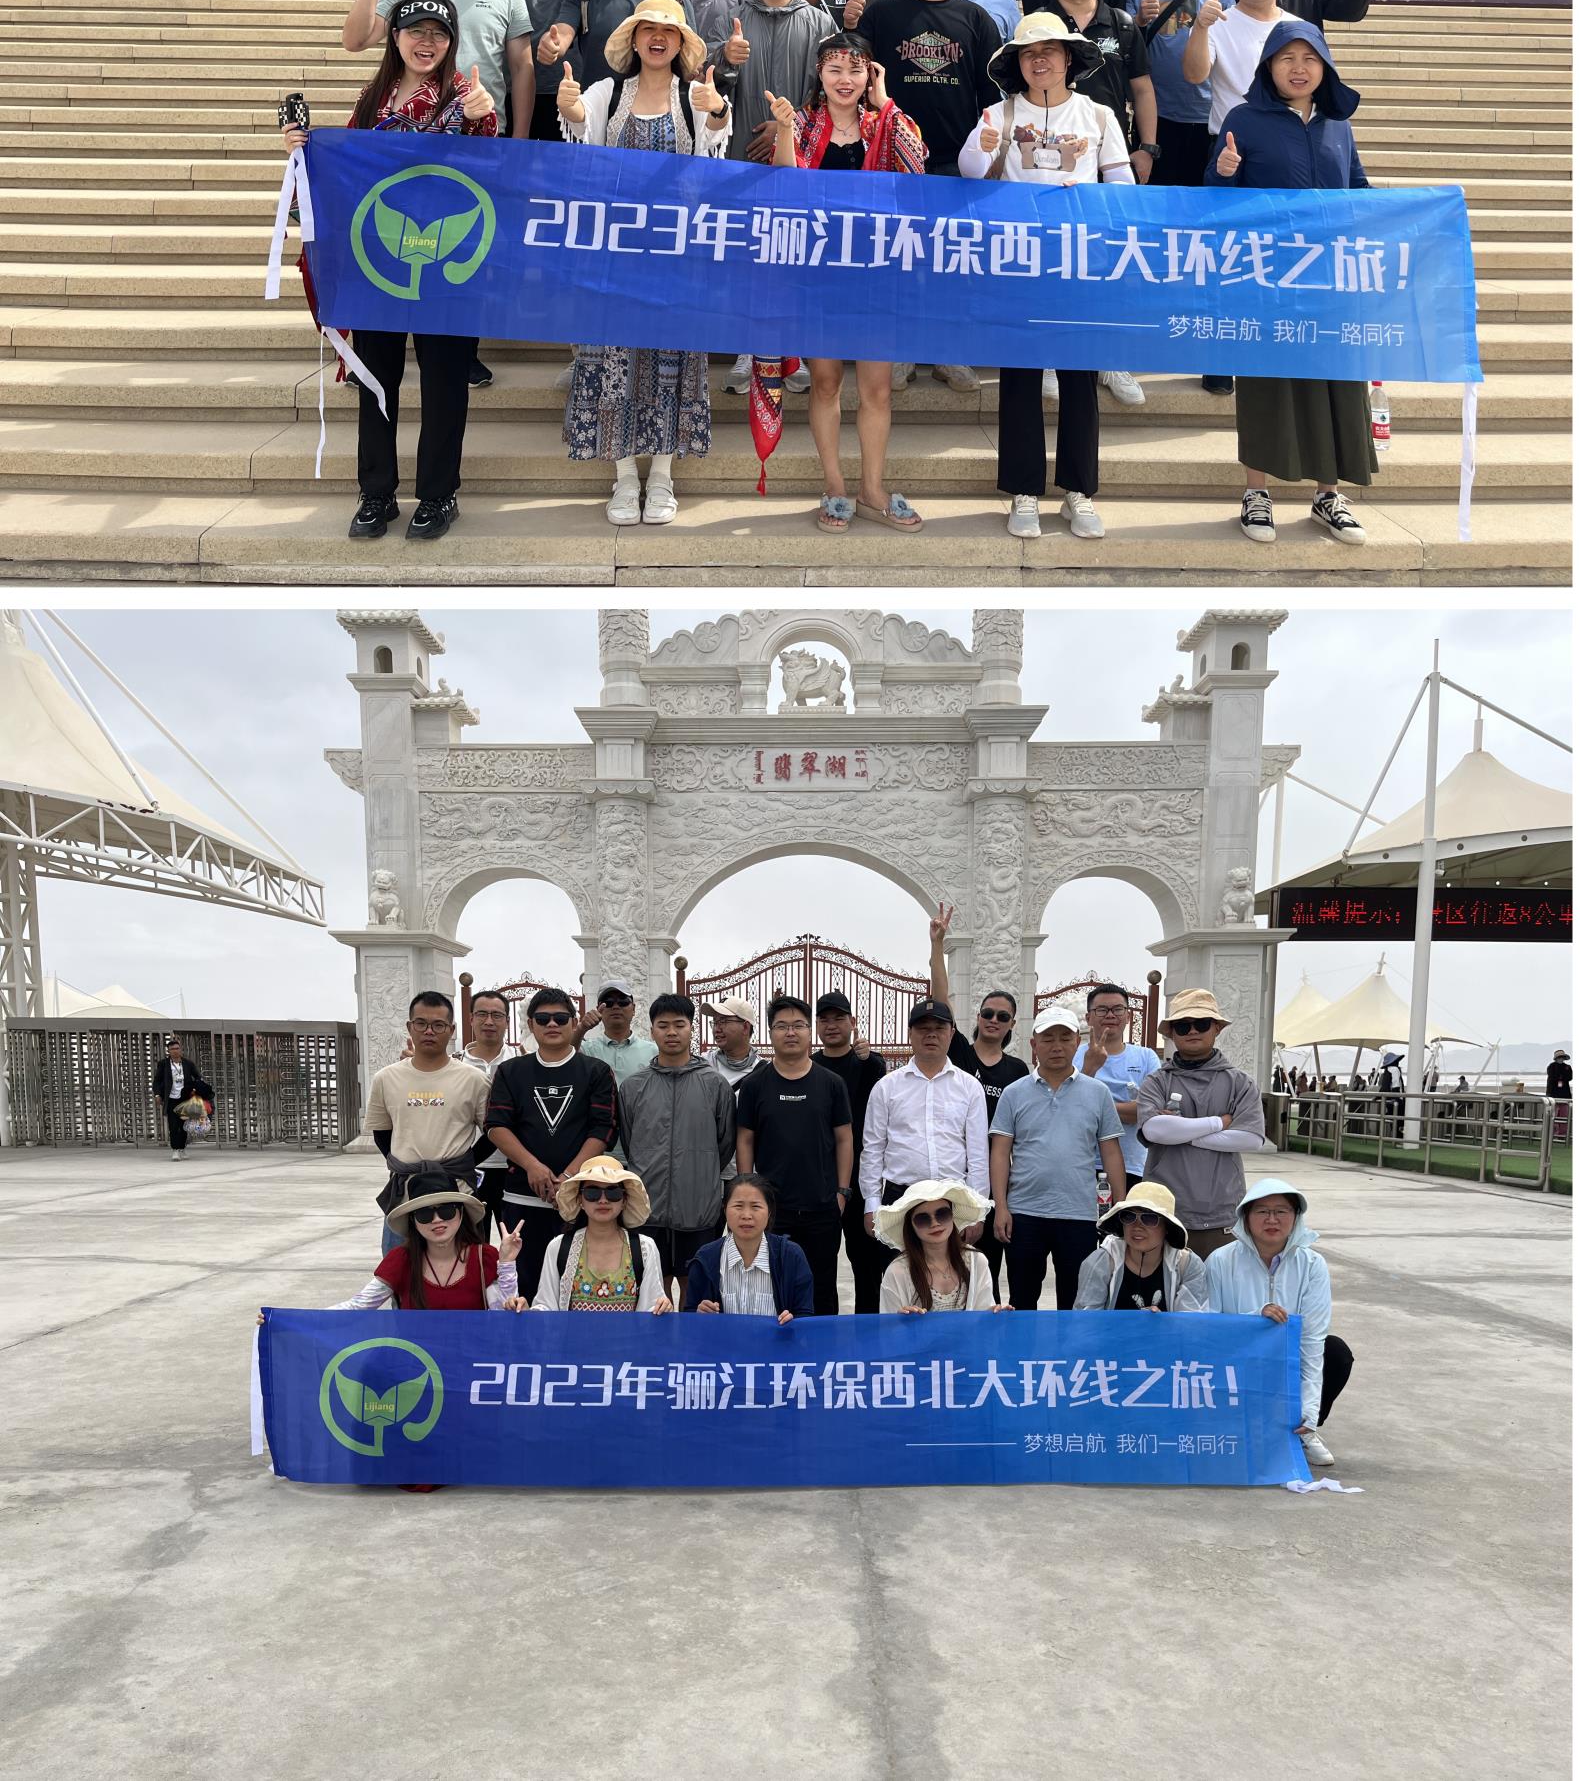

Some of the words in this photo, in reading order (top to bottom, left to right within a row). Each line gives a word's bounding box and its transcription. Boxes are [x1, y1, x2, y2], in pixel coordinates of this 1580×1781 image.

[400, 1, 452, 22] SPOR
[901, 40, 959, 64] BROOKLYN
[904, 75, 931, 83] SUPERIOR
[402, 234, 437, 250] Lijiang
[523, 198, 1410, 293] 2023年骊江环保西北大环线之旅！
[1167, 315, 1262, 342] 梦想启航
[1273, 319, 1405, 347] 我们一路同行
[774, 751, 847, 782] 翡翠湖
[470, 1359, 1240, 1410] 2023年骊江环保西北大环线之旅！
[363, 1402, 396, 1413] Lijiang
[1023, 1433, 1108, 1455] 梦想启航
[1116, 1434, 1238, 1456] 我们一路同行
